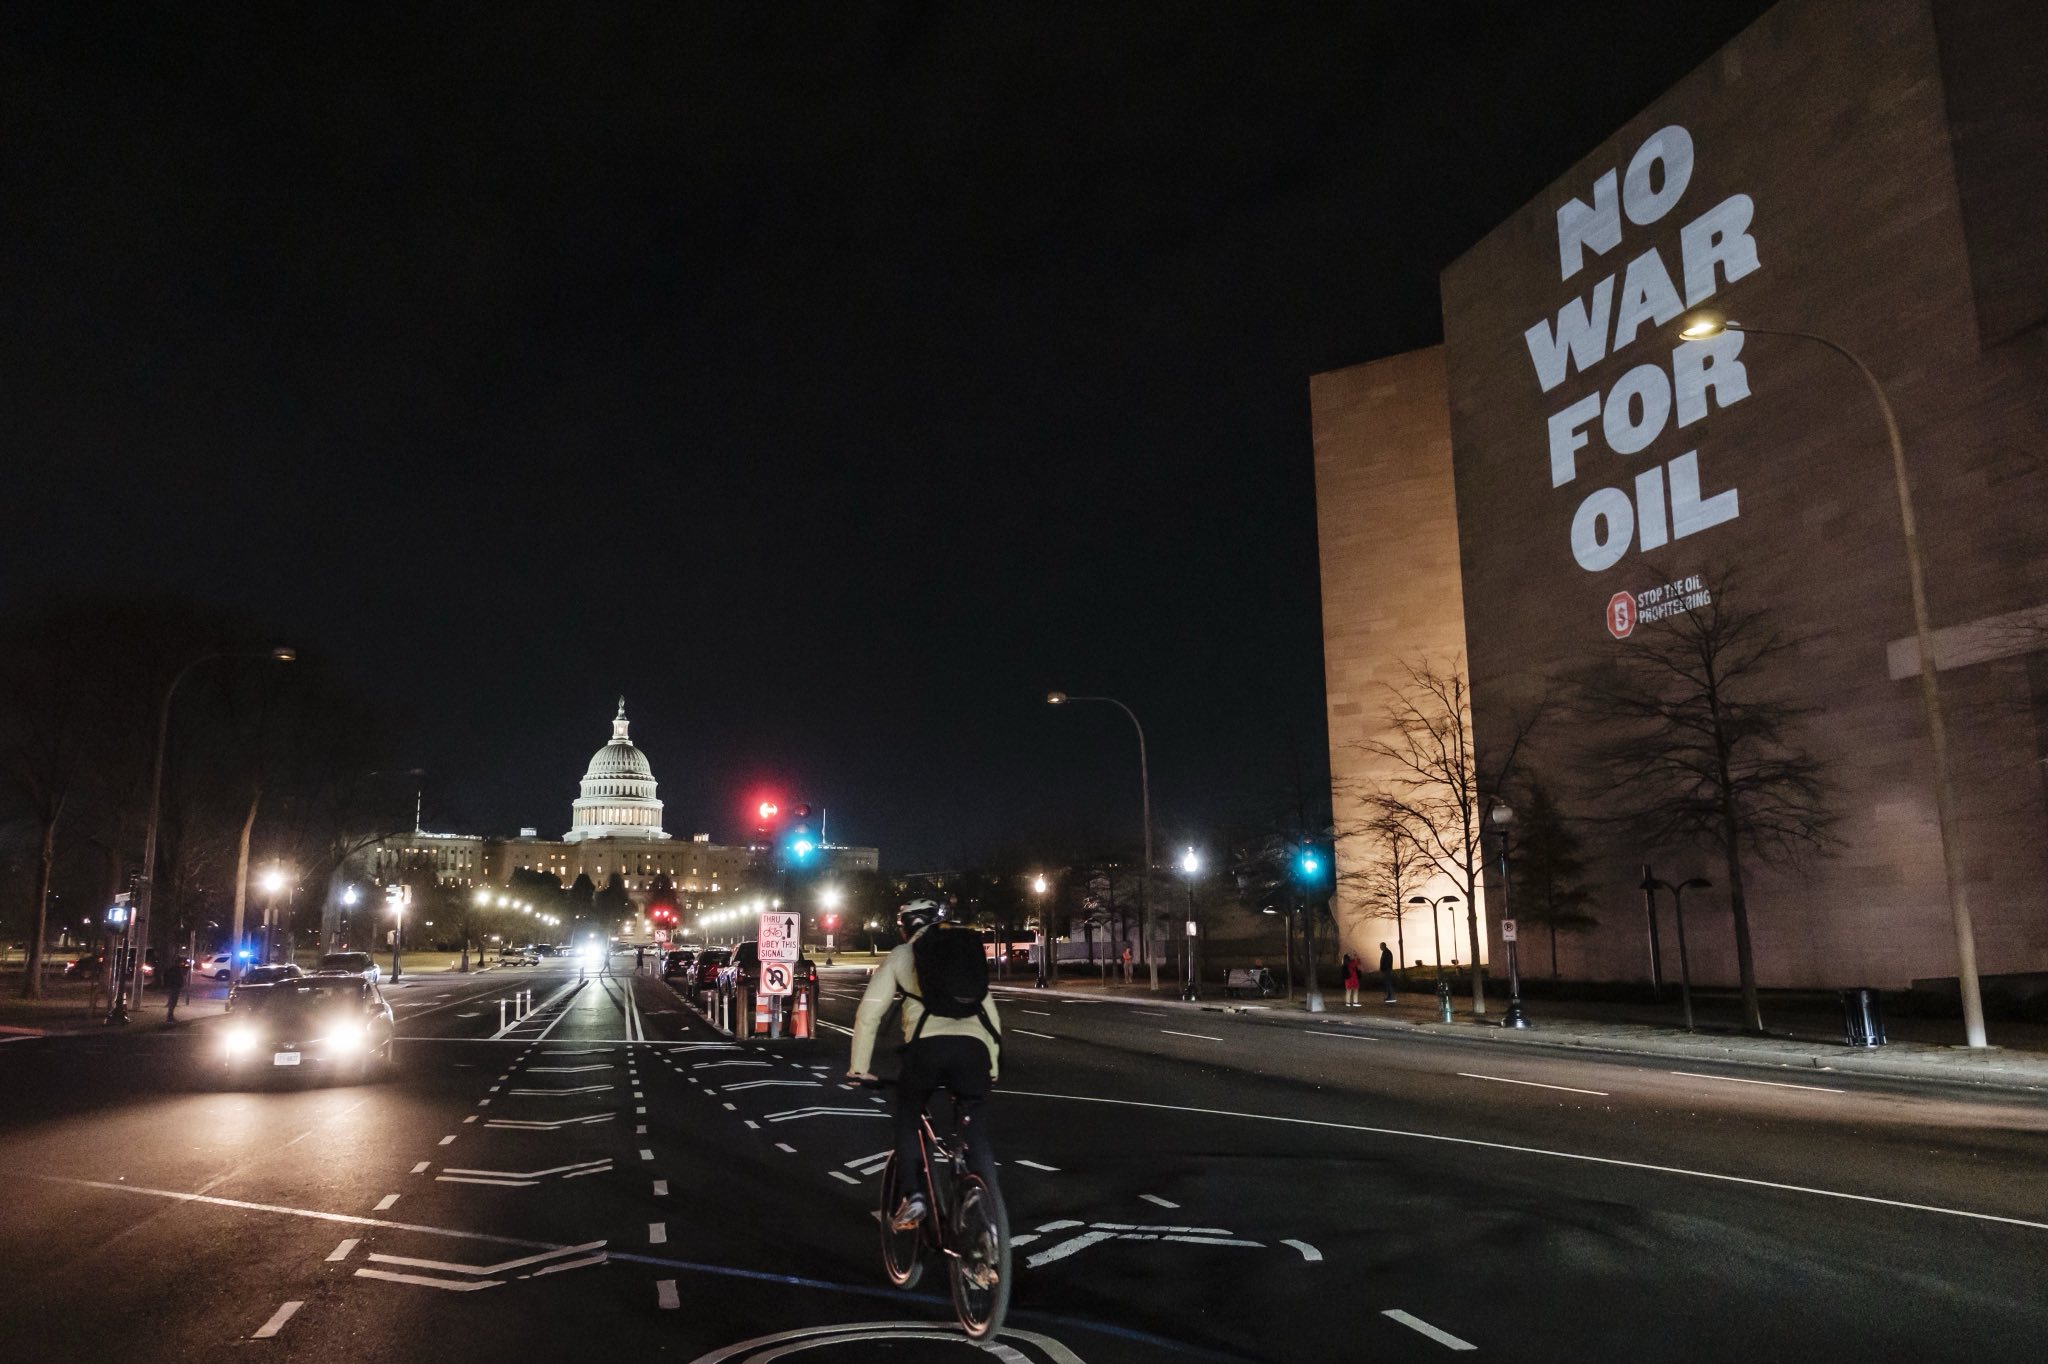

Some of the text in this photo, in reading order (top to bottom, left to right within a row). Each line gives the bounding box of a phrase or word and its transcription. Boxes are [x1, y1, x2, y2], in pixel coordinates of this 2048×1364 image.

[1557, 125, 1694, 281] NO
[1525, 193, 1761, 393] WAR
[1548, 322, 1752, 488] FOR
[1571, 450, 1740, 571] OIL
[1638, 575, 1703, 608] STOP THE OIL
[1639, 590, 1711, 624] PROFITEERING
[763, 915, 780, 923] THRU
[761, 950, 785, 958] SIGNAL
[782, 940, 797, 948] THIS
